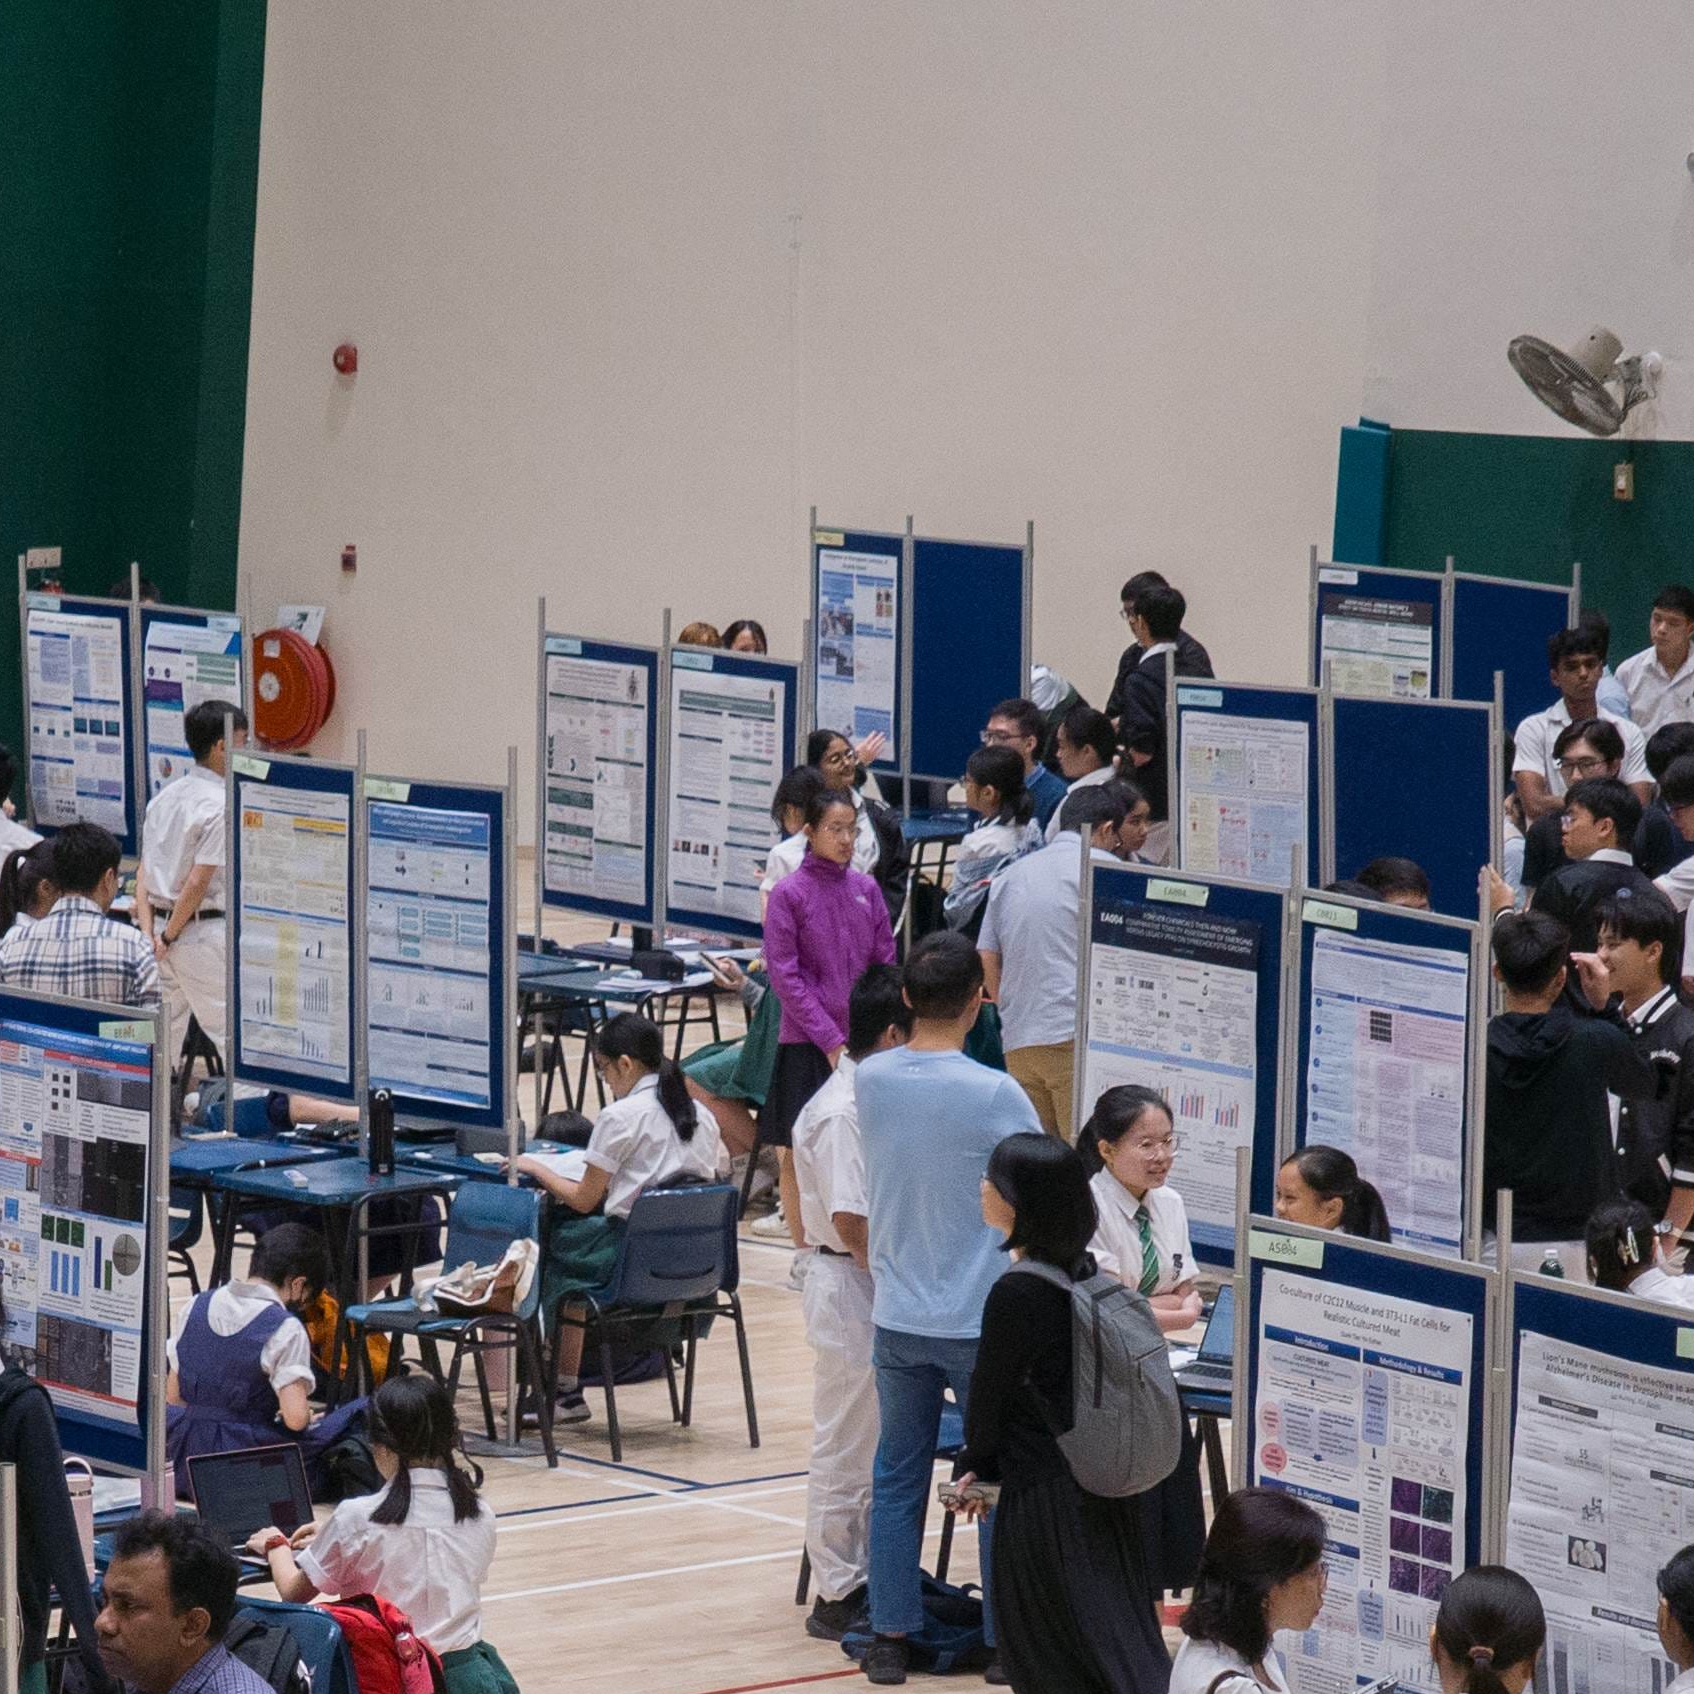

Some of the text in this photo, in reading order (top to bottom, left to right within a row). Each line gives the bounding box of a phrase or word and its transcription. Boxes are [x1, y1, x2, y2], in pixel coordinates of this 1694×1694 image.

[1323, 1310, 1350, 1326] Realistic
[1352, 1317, 1381, 1333] Cultured
[1383, 1324, 1400, 1338] Meat
[1346, 1299, 1369, 1314] Muscle
[1371, 1304, 1384, 1318] and
[1409, 1314, 1421, 1327] Fat
[1422, 1317, 1438, 1331] Cells
[1440, 1323, 1451, 1333] for
[1592, 1374, 1621, 1391] Disease
